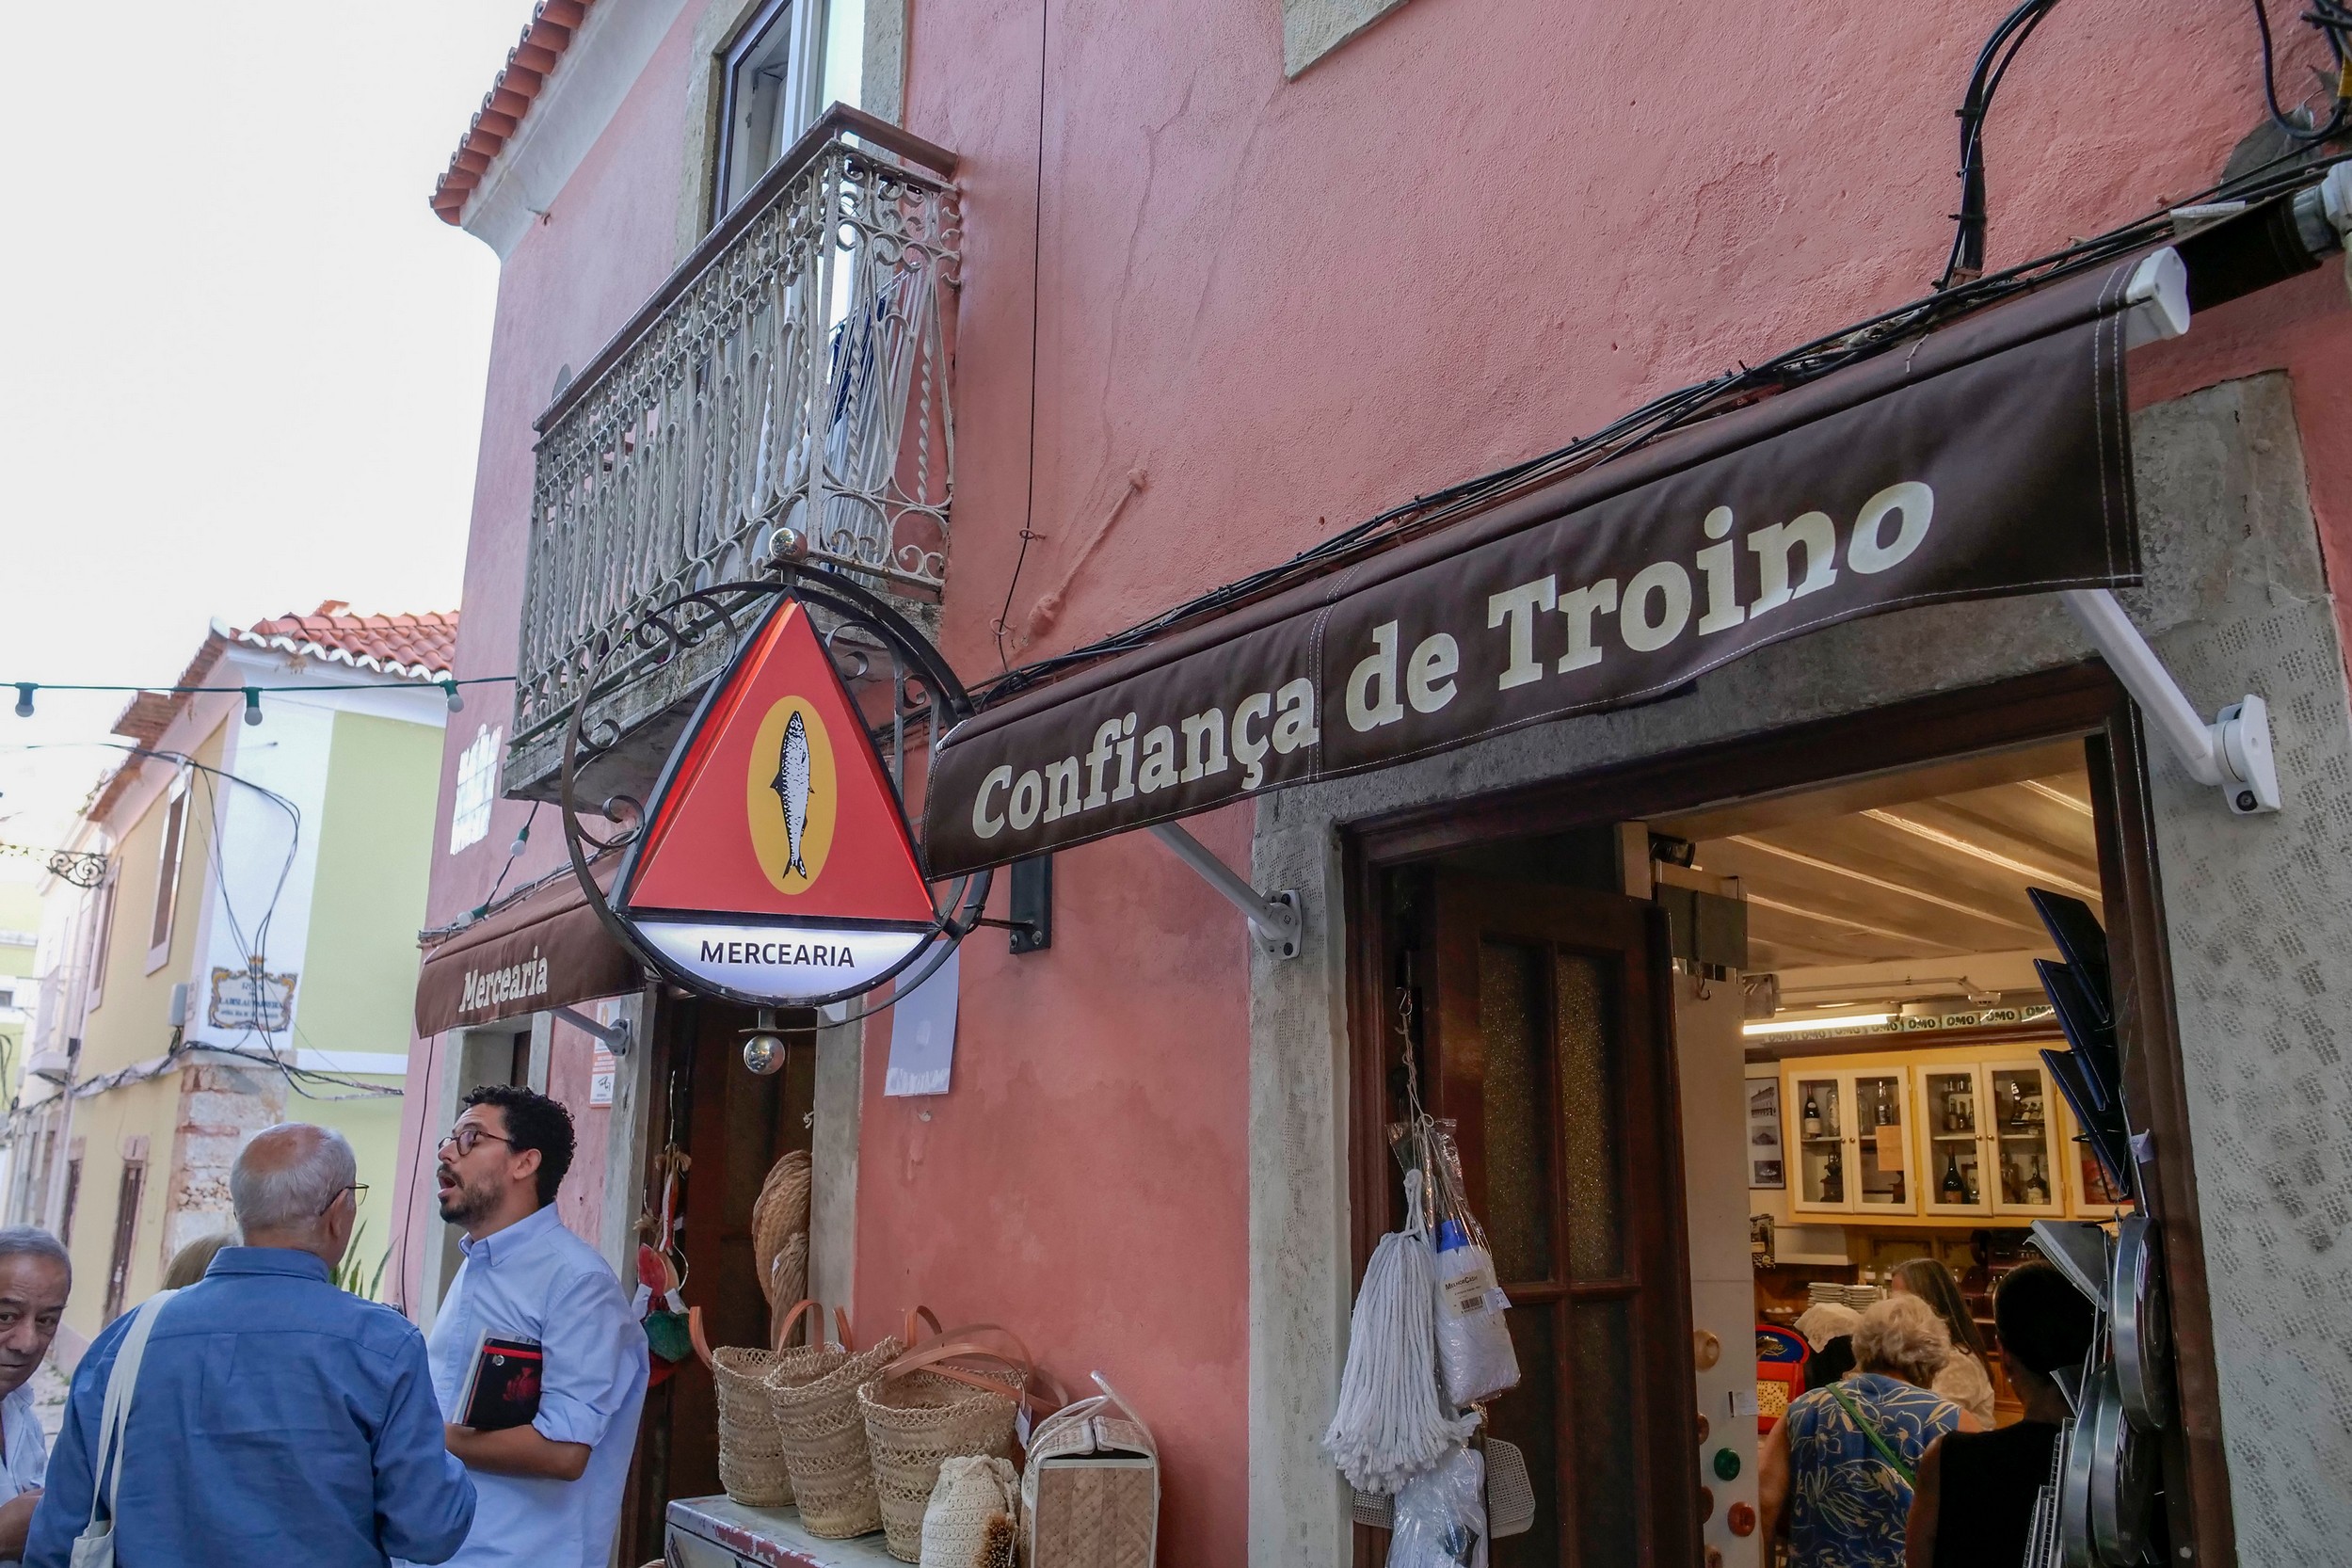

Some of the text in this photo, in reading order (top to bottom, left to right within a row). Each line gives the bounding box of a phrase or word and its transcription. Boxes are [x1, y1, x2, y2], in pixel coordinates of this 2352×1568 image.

[971, 481, 1934, 839] Confiança de Troino
[700, 939, 856, 968] MERCEARIA
[458, 945, 548, 1013] Mercearia
[1908, 1018, 1936, 1030] OMO
[1946, 1016, 1975, 1027] OMO
[1986, 1011, 2015, 1022] OMO
